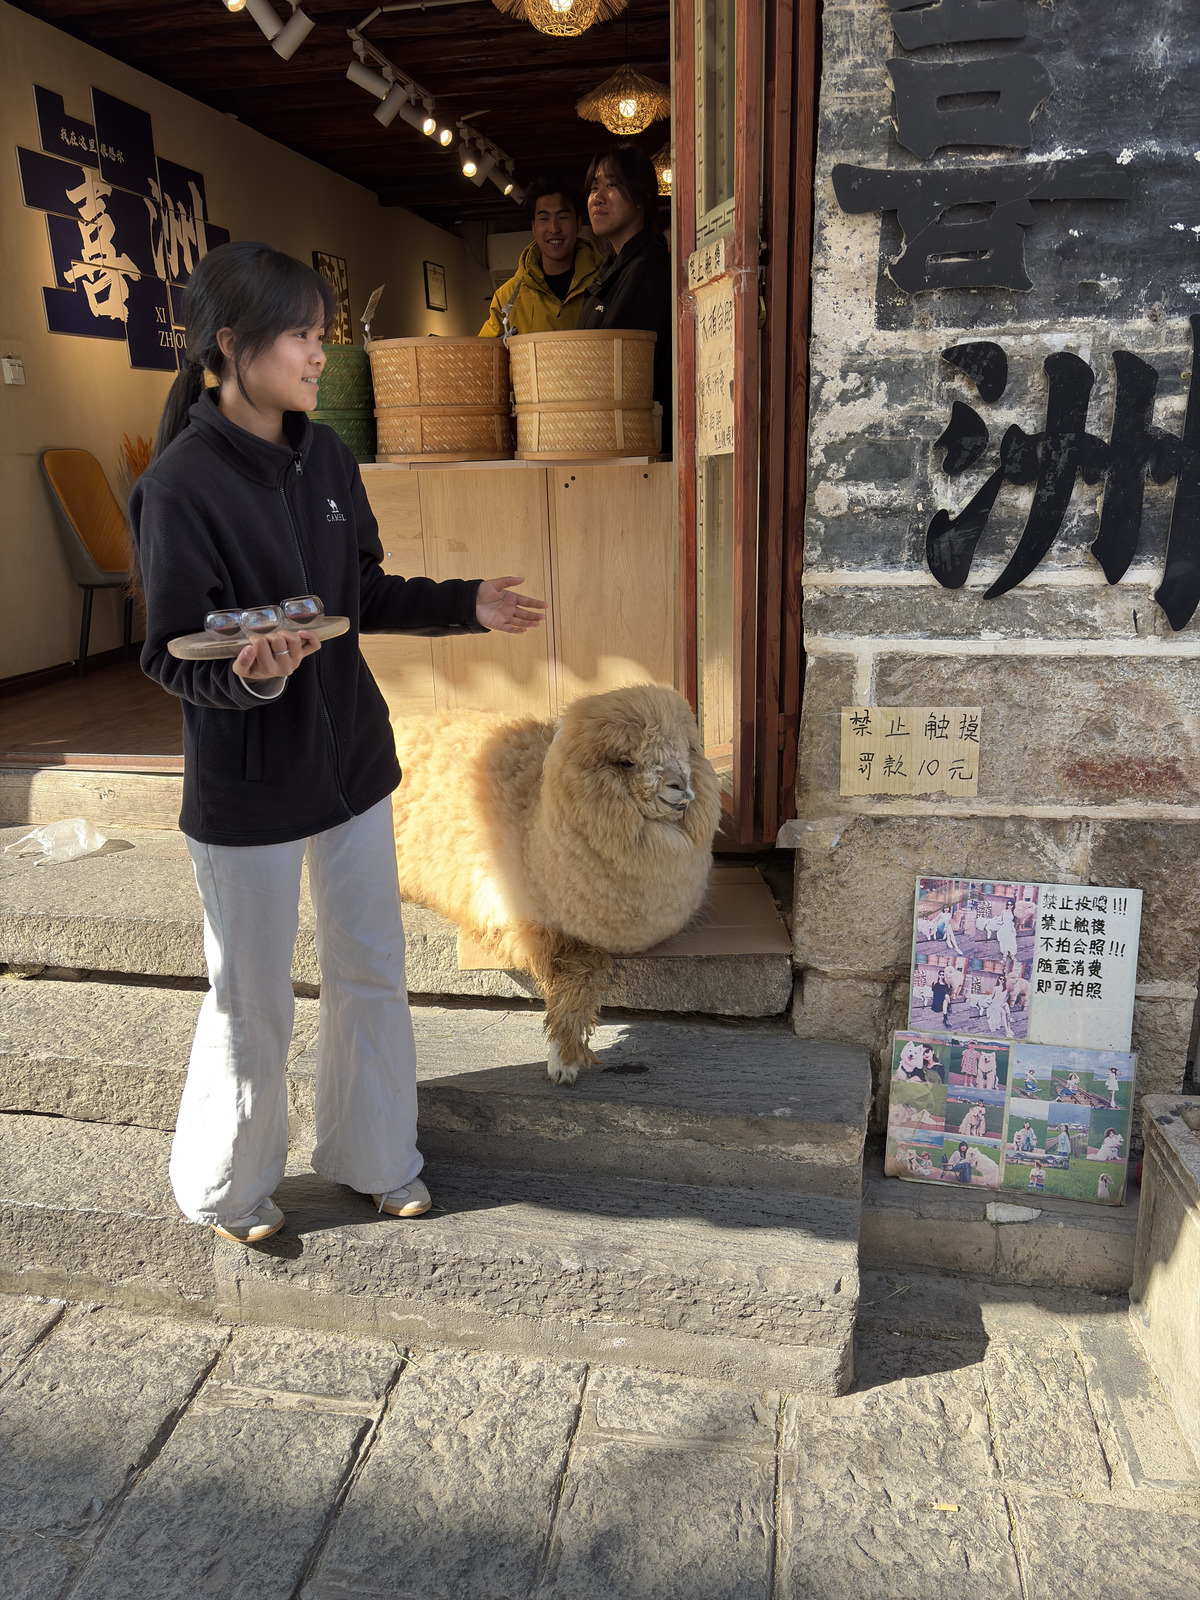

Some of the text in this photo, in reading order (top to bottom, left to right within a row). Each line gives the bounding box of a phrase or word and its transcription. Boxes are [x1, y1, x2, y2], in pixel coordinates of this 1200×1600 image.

[154, 306, 167, 324] XI
[326, 513, 347, 522] CAMEL
[849, 709, 980, 743] 禁止触摸
[857, 752, 974, 781] 罚款10元
[1036, 957, 1103, 979] 随意消费
[1036, 978, 1103, 1000] 即可拍照
